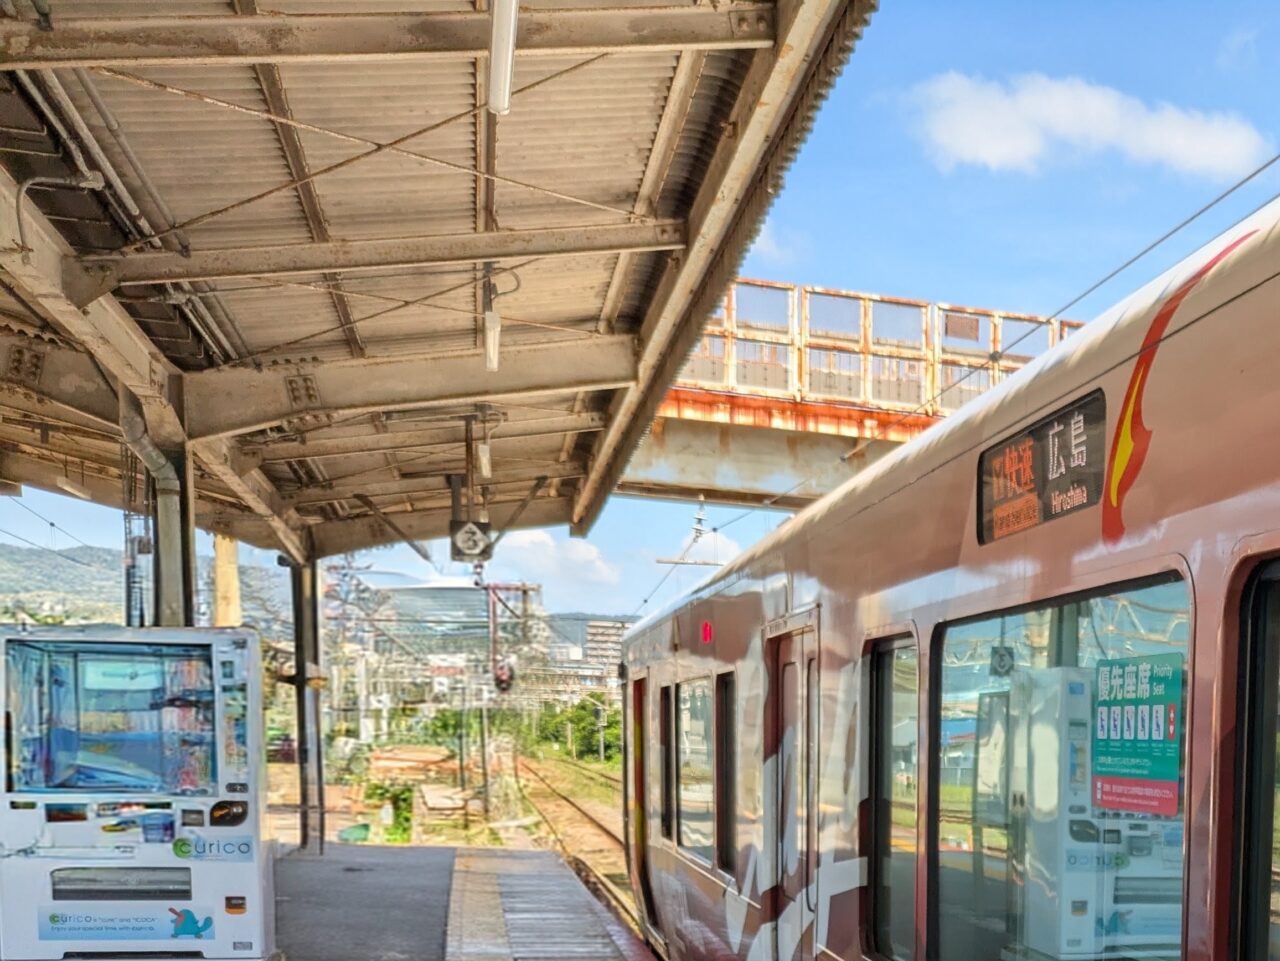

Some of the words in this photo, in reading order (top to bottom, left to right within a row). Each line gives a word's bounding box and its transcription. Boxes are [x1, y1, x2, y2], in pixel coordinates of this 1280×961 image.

[1049, 411, 1087, 481] 広島
[1052, 483, 1088, 515] Hiroshima
[1153, 665, 1173, 679] Priority
[1098, 662, 1151, 701] 優先座席
[1153, 682, 1165, 696] Seat
[174, 838, 250, 856] curico
[50, 914, 92, 925] curico
